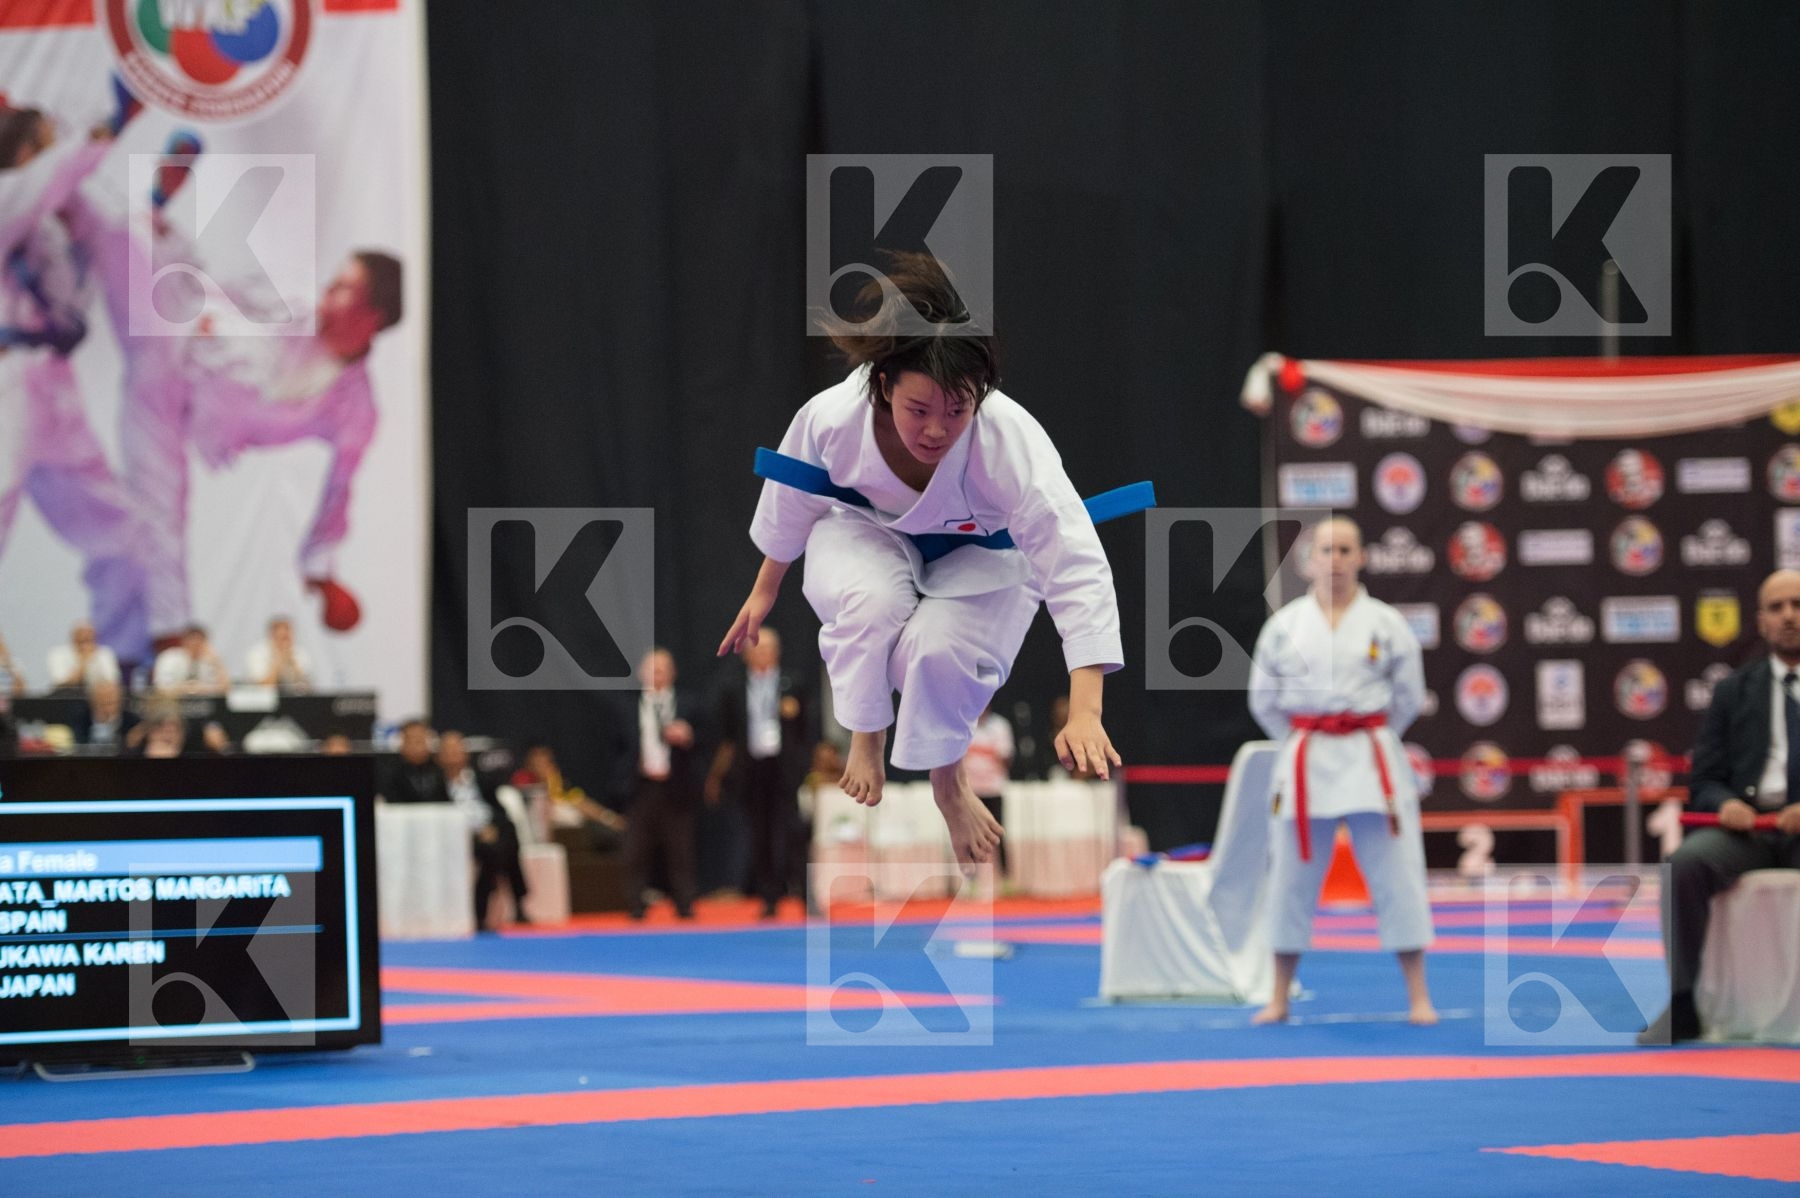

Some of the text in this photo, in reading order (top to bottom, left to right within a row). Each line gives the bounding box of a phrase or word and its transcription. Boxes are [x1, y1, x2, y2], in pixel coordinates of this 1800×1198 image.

[17, 850, 97, 873] Female
[1457, 824, 1495, 877] 2
[155, 875, 291, 900] MARGARITA
[0, 909, 67, 934] SPAIN
[83, 940, 165, 966] KAREN
[0, 973, 75, 999] JAPAN
